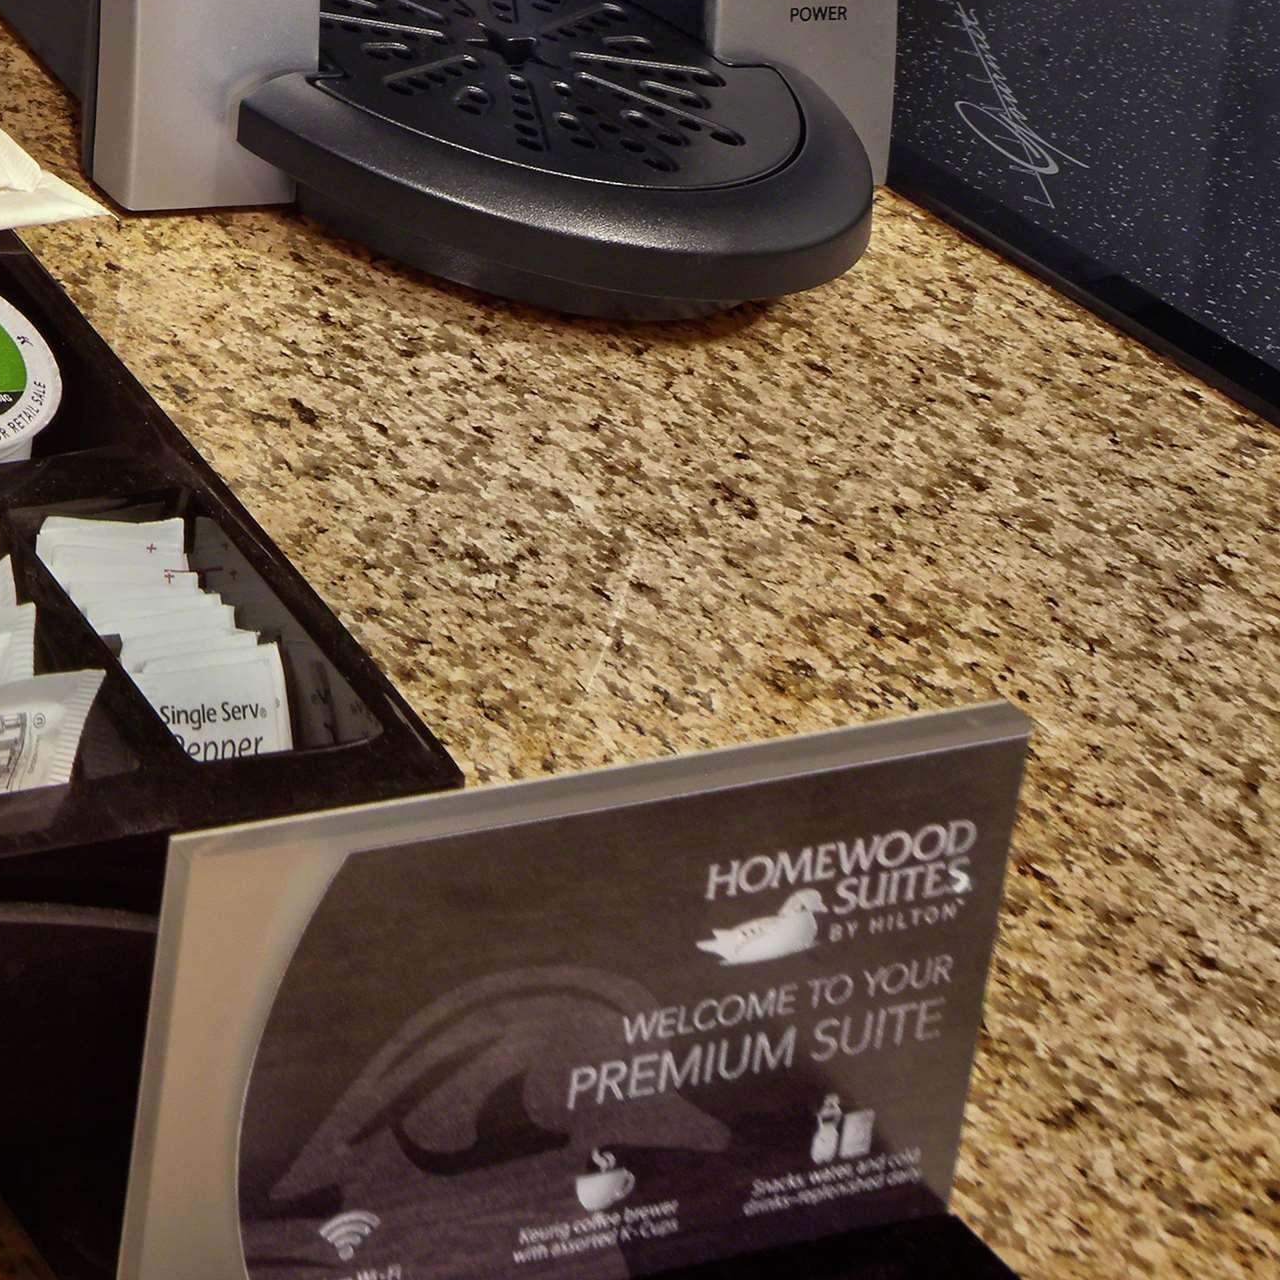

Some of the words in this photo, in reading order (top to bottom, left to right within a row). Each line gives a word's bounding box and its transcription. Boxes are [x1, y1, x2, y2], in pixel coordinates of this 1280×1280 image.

[789, 4, 849, 23] POWER
[159, 703, 217, 730] Single
[221, 701, 259, 721] Serv
[704, 818, 978, 901] HOMEWOOD
[831, 857, 974, 916] SUITES
[827, 920, 858, 943] BY
[868, 903, 957, 934] HILTON
[622, 982, 800, 1045] WELCOME
[807, 974, 855, 1009] TO
[862, 953, 955, 999] YOUR
[566, 1024, 798, 1111] PREMIUM
[809, 997, 948, 1064] SUITE
